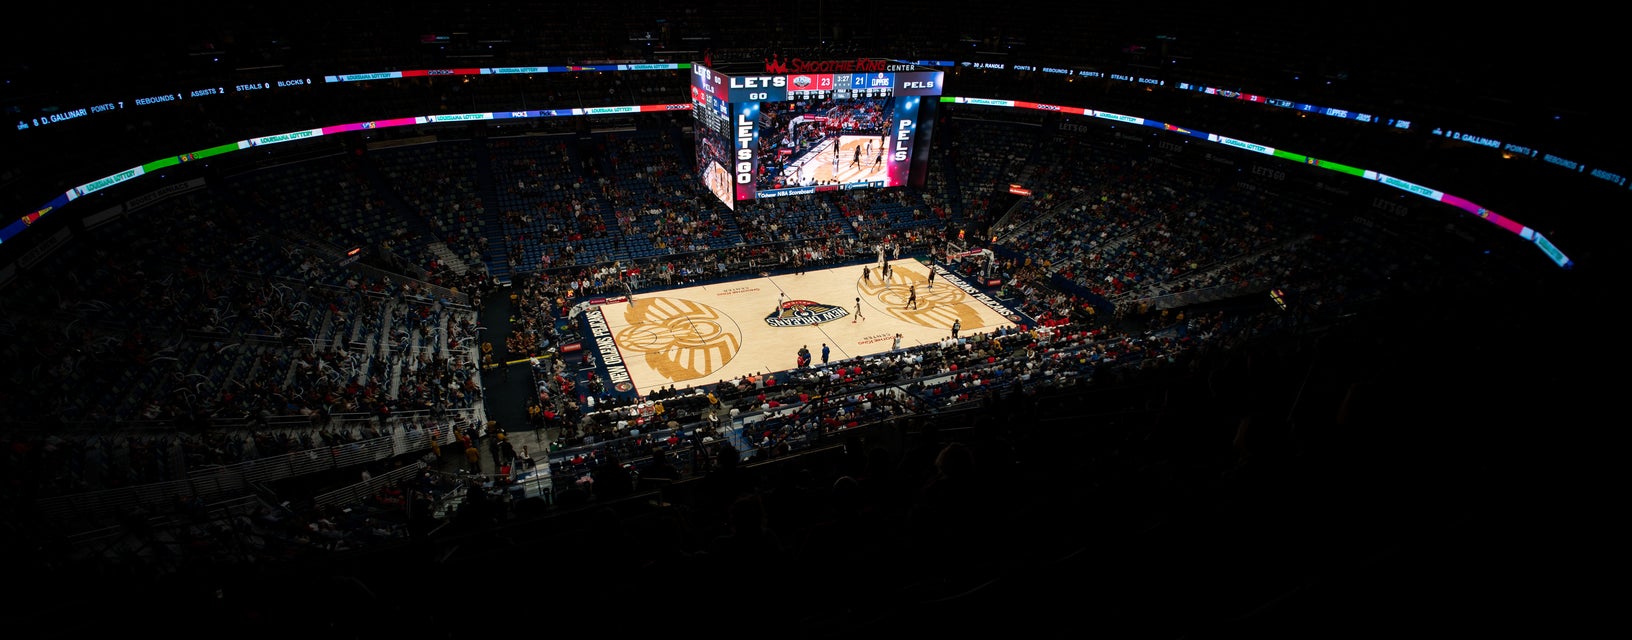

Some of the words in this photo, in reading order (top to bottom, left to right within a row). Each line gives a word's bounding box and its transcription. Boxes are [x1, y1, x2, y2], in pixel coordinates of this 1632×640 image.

[856, 57, 888, 72] KING
[886, 64, 916, 72] CENTER
[236, 83, 262, 91] STEALS
[278, 79, 304, 87] BLOCKS
[730, 76, 787, 88] LETS
[821, 78, 831, 86] 23
[855, 77, 864, 85] 21
[191, 88, 216, 97] ASSISTS
[136, 94, 175, 106] REBOUNDS
[91, 103, 115, 113] POINTS
[1326, 108, 1348, 118] CLIPPERS
[33, 118, 39, 126] 8
[42, 117, 50, 125] D.
[51, 108, 88, 123] GALLINARI
[895, 119, 912, 161] PELS
[1462, 134, 1501, 148] GALLINARI
[1505, 144, 1531, 155] POINTS
[1544, 154, 1577, 169] REBOUNDS
[1591, 168, 1620, 183] ASSISTS
[943, 273, 980, 297] ORLEANS
[973, 292, 1014, 316] PELICANS
[823, 307, 849, 321] NEW
[585, 310, 611, 337] PELICANS
[769, 315, 822, 327] ORLEANS
[596, 336, 623, 365] ORLEANS
[608, 365, 631, 384] NEW
